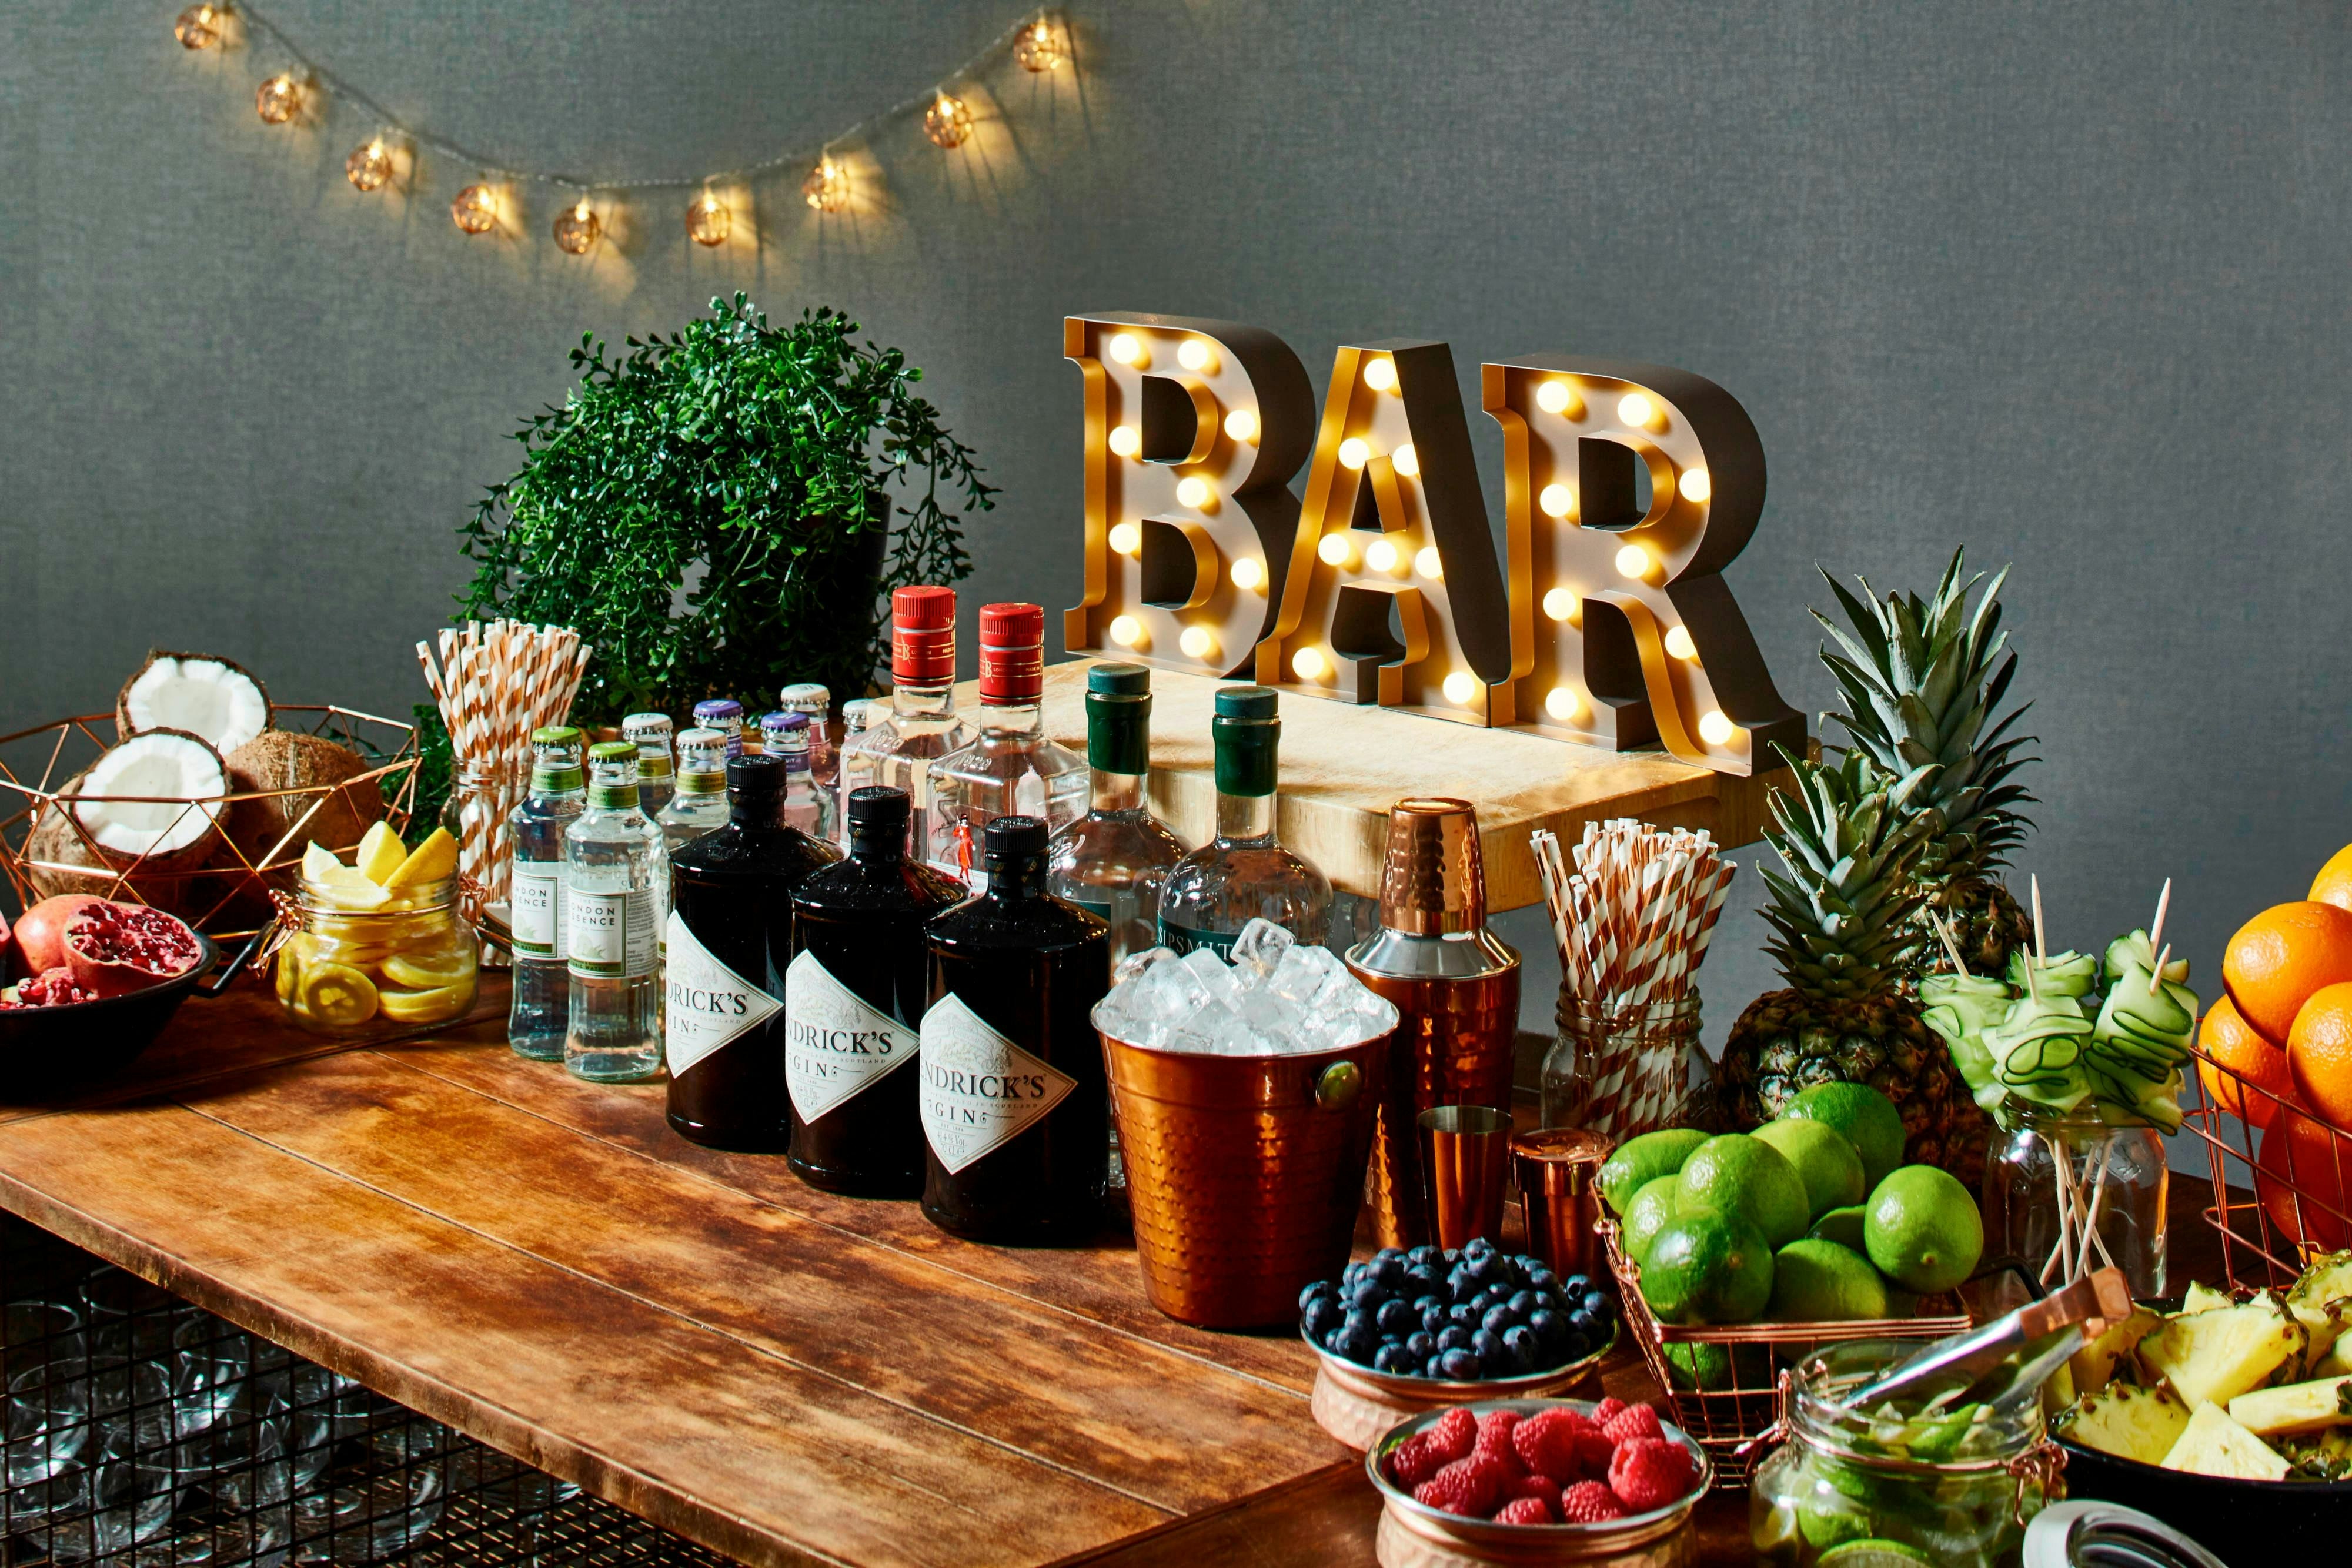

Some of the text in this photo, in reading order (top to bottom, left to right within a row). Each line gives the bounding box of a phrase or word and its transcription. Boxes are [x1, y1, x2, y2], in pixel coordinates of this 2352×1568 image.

[1064, 310, 1808, 777] BAR
[794, 1055, 827, 1077] GIN
[936, 1102, 975, 1125] GIN
